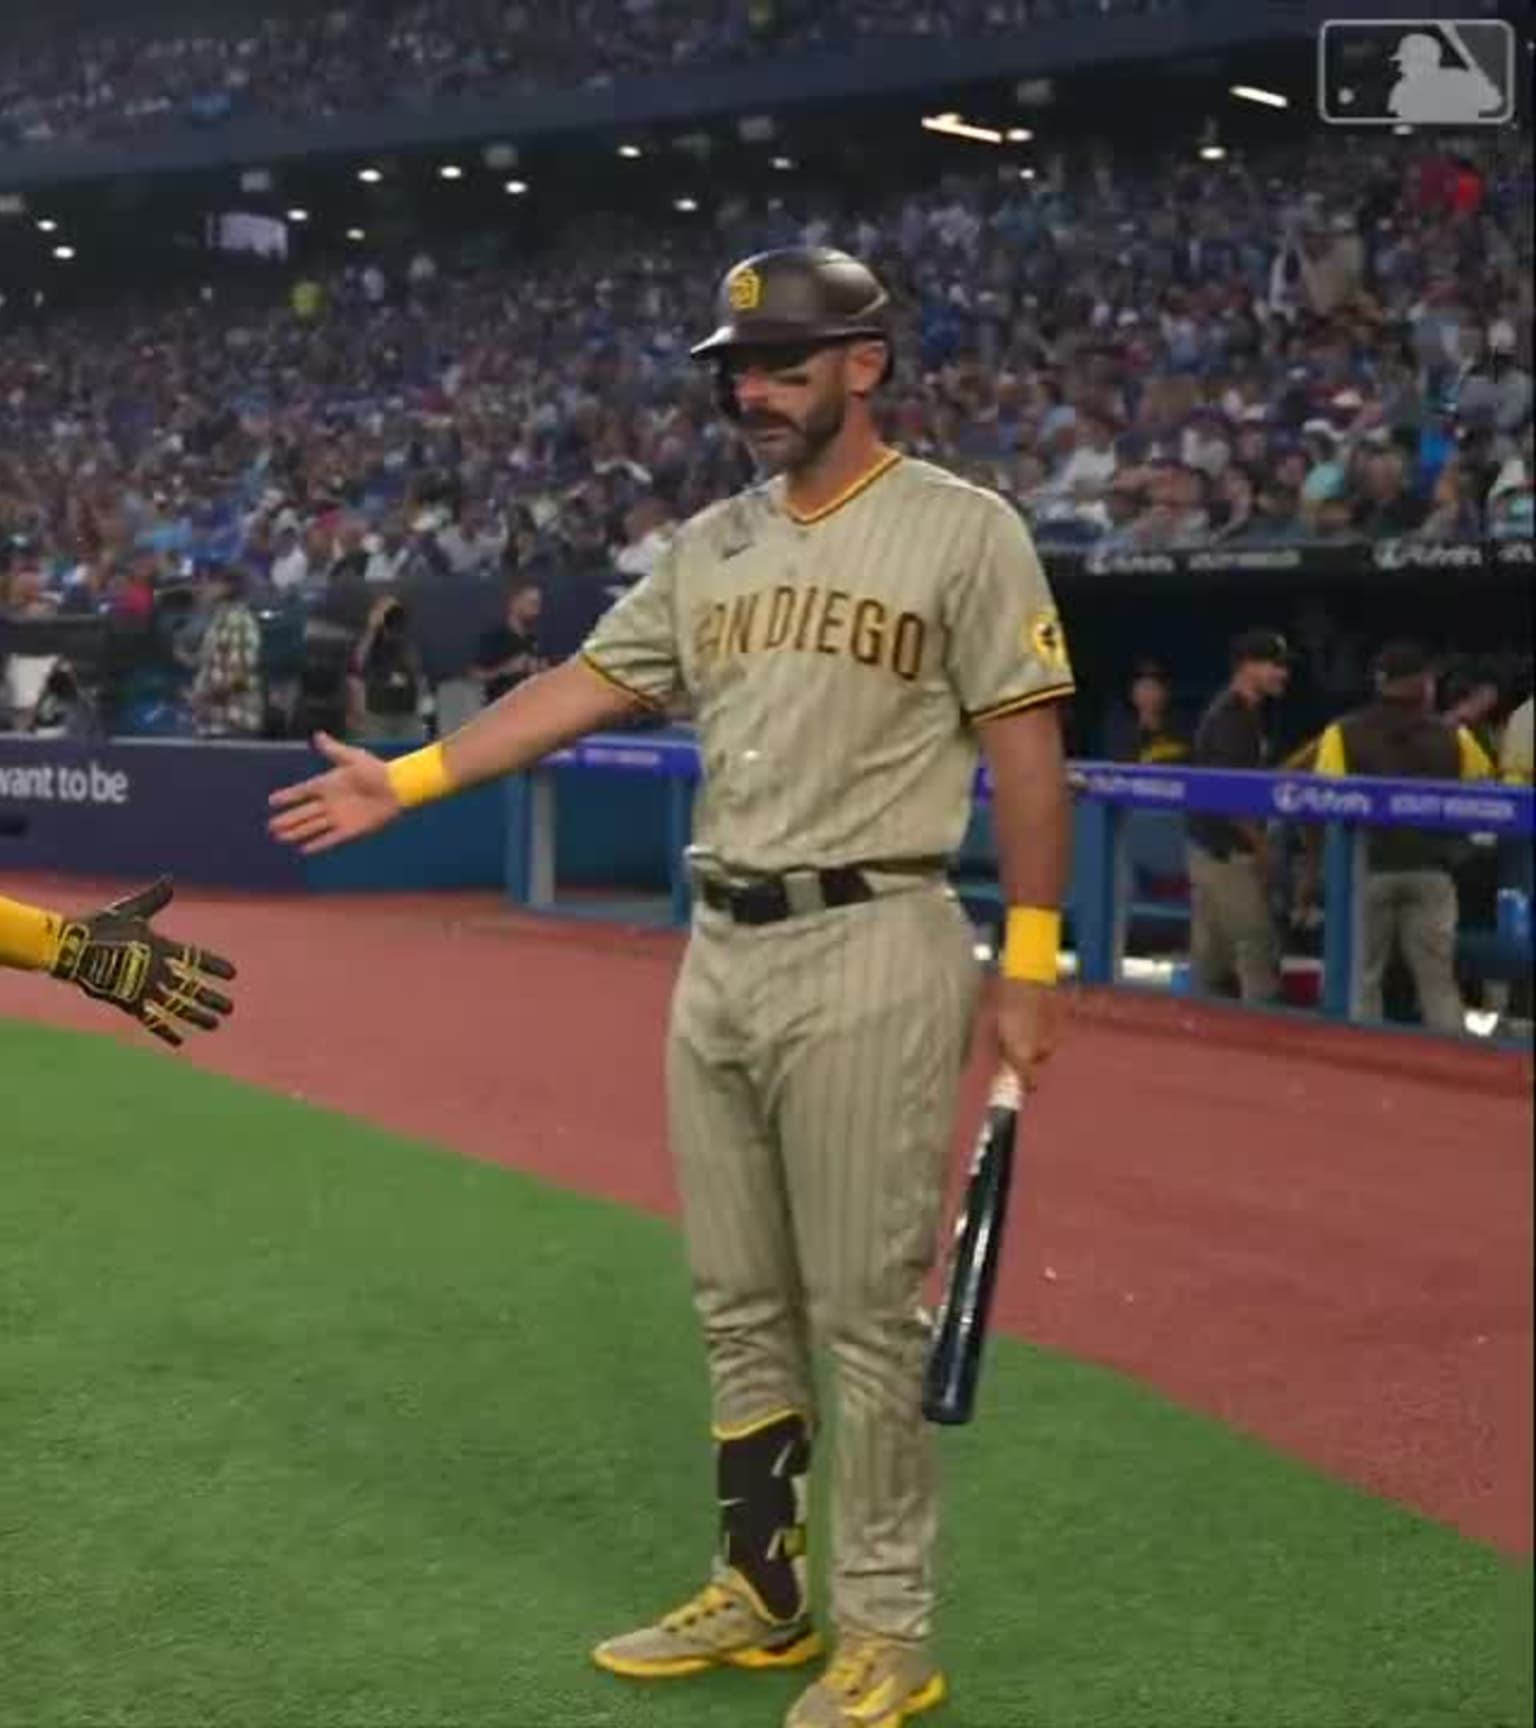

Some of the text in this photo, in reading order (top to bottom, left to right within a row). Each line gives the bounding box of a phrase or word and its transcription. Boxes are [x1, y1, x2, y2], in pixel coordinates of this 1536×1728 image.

[765, 583, 926, 683] DIEGO
[58, 766, 89, 800] to
[90, 761, 128, 803] be
